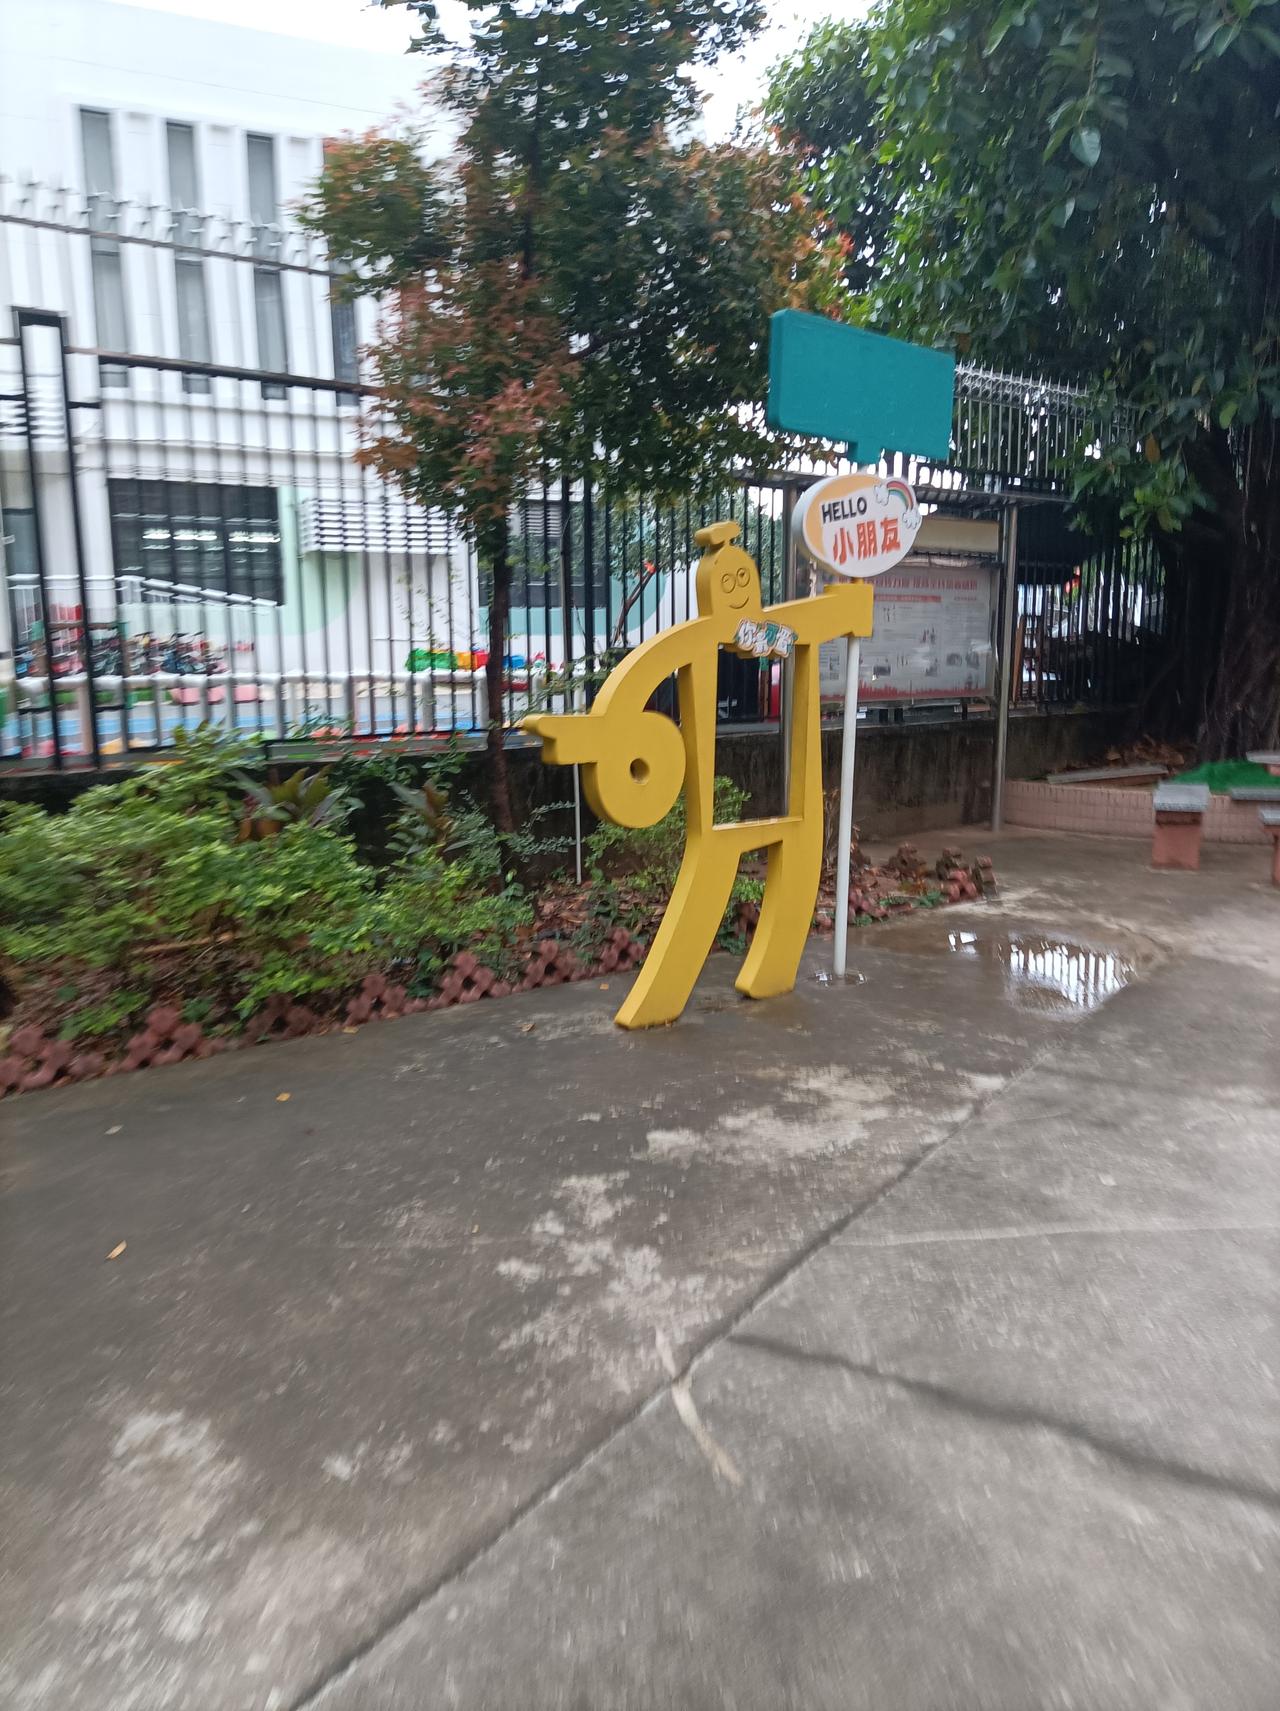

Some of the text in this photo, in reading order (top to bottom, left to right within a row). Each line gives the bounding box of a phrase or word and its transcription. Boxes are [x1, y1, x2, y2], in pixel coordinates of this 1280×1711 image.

[821, 496, 867, 523] HELLO
[833, 517, 902, 565] 小朋友
